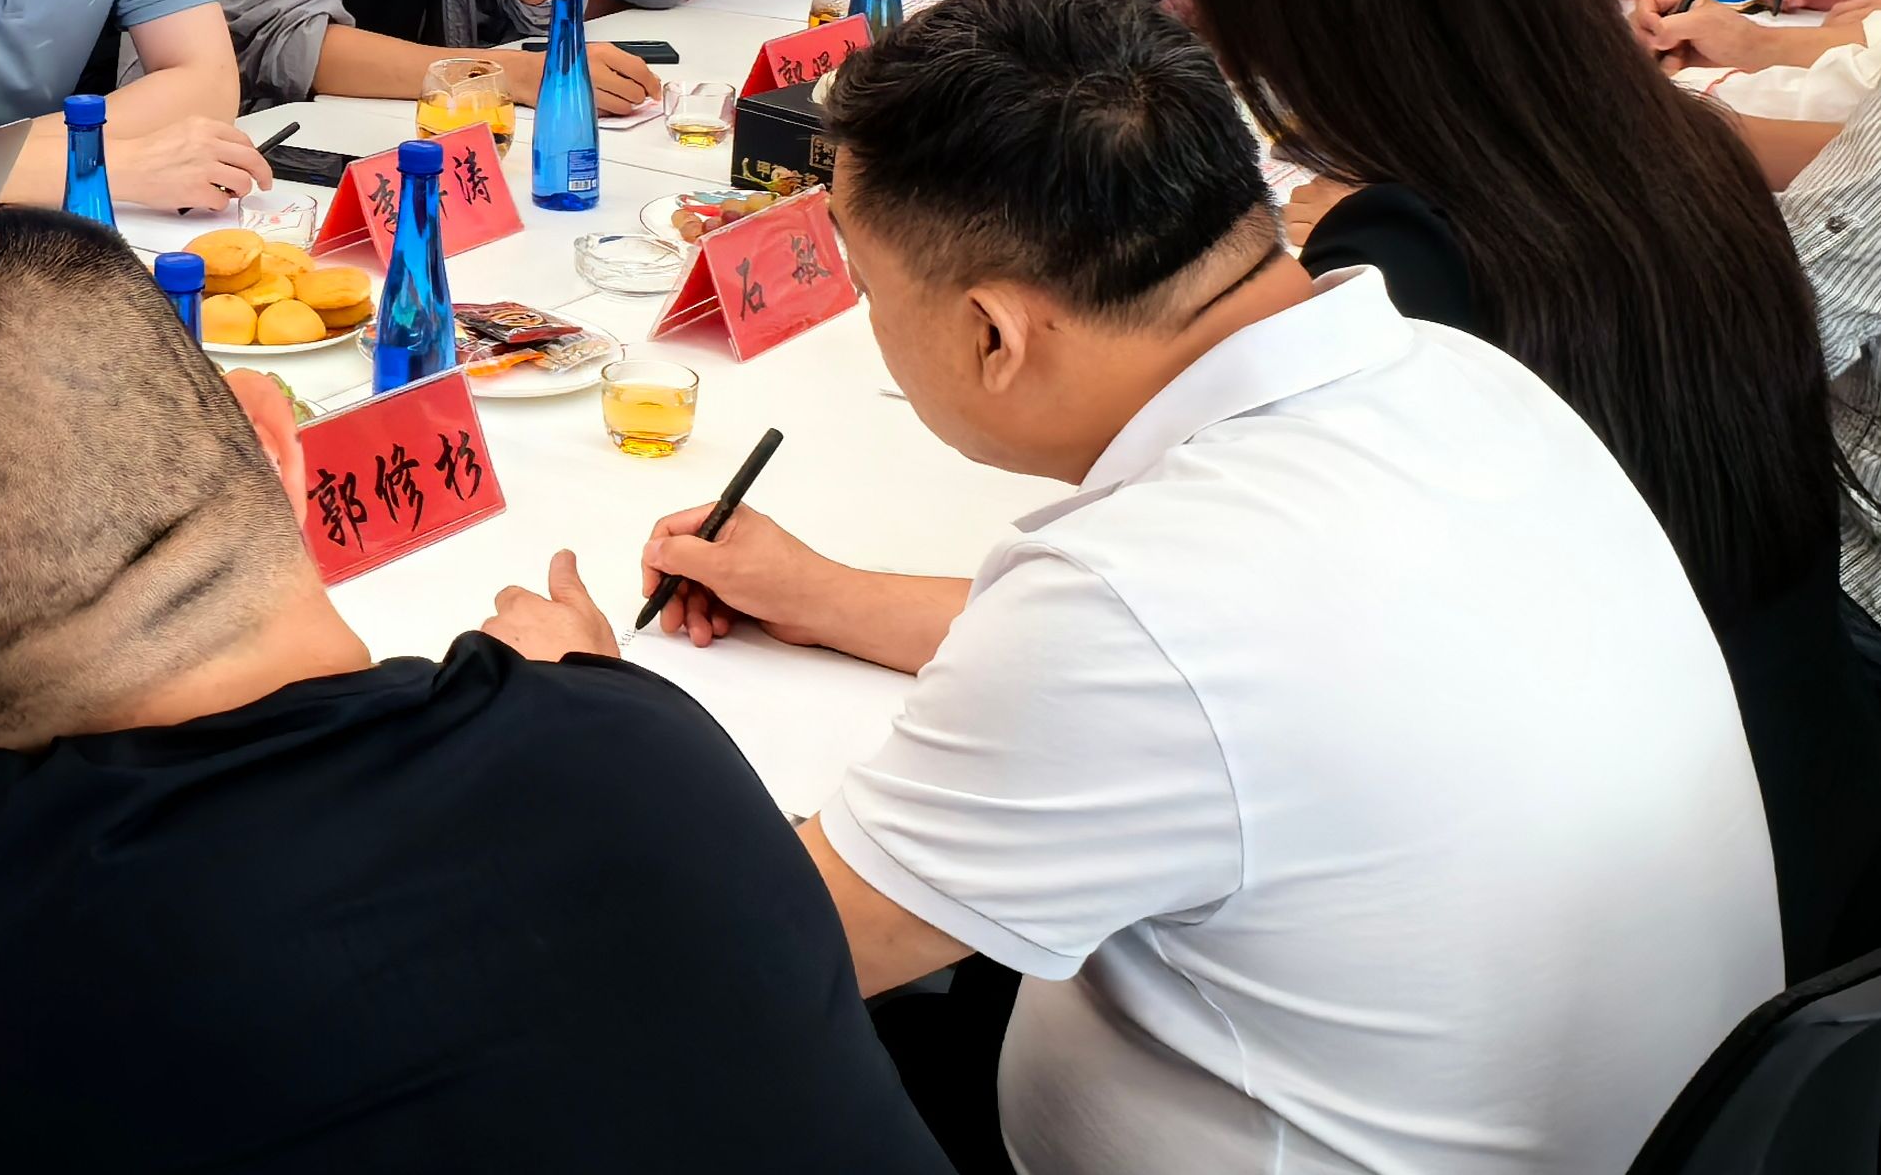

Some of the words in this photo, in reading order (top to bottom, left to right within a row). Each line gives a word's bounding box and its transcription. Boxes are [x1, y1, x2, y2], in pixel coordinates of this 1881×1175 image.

[368, 146, 492, 235] 李涛
[735, 233, 832, 321] 石敏
[307, 430, 482, 553] 郭修杉
